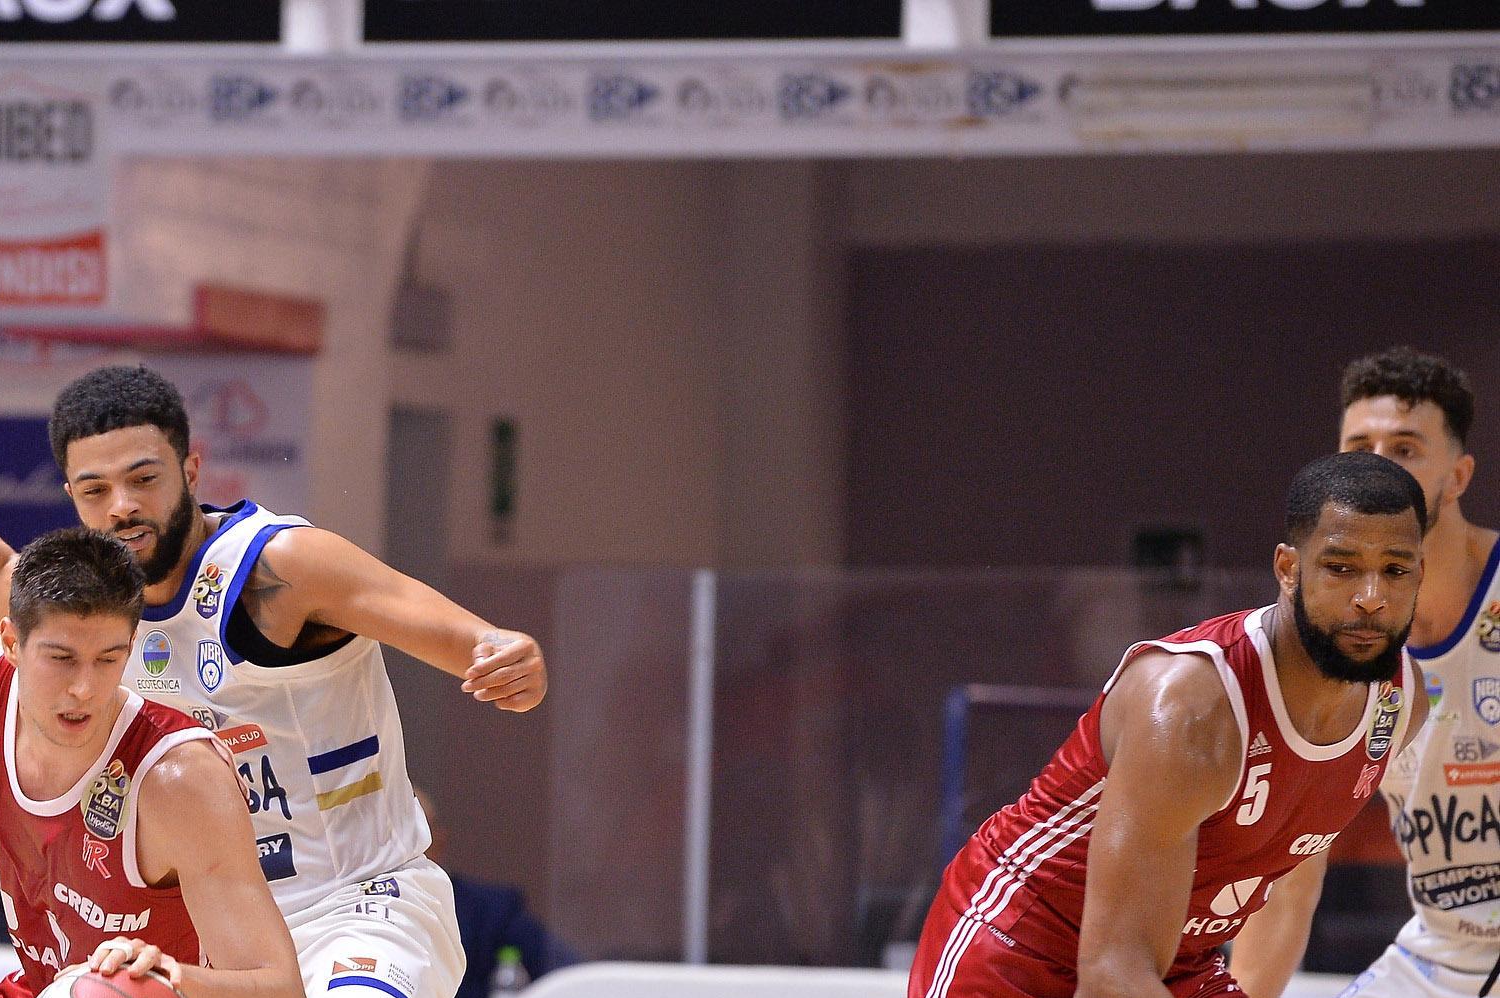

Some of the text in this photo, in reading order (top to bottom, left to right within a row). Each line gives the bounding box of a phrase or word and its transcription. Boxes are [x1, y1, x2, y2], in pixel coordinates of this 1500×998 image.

[137, 679, 181, 691] ECOTECNICA
[242, 731, 260, 742] SUD
[1236, 762, 1273, 826] 5
[53, 882, 151, 933] CREDEM
